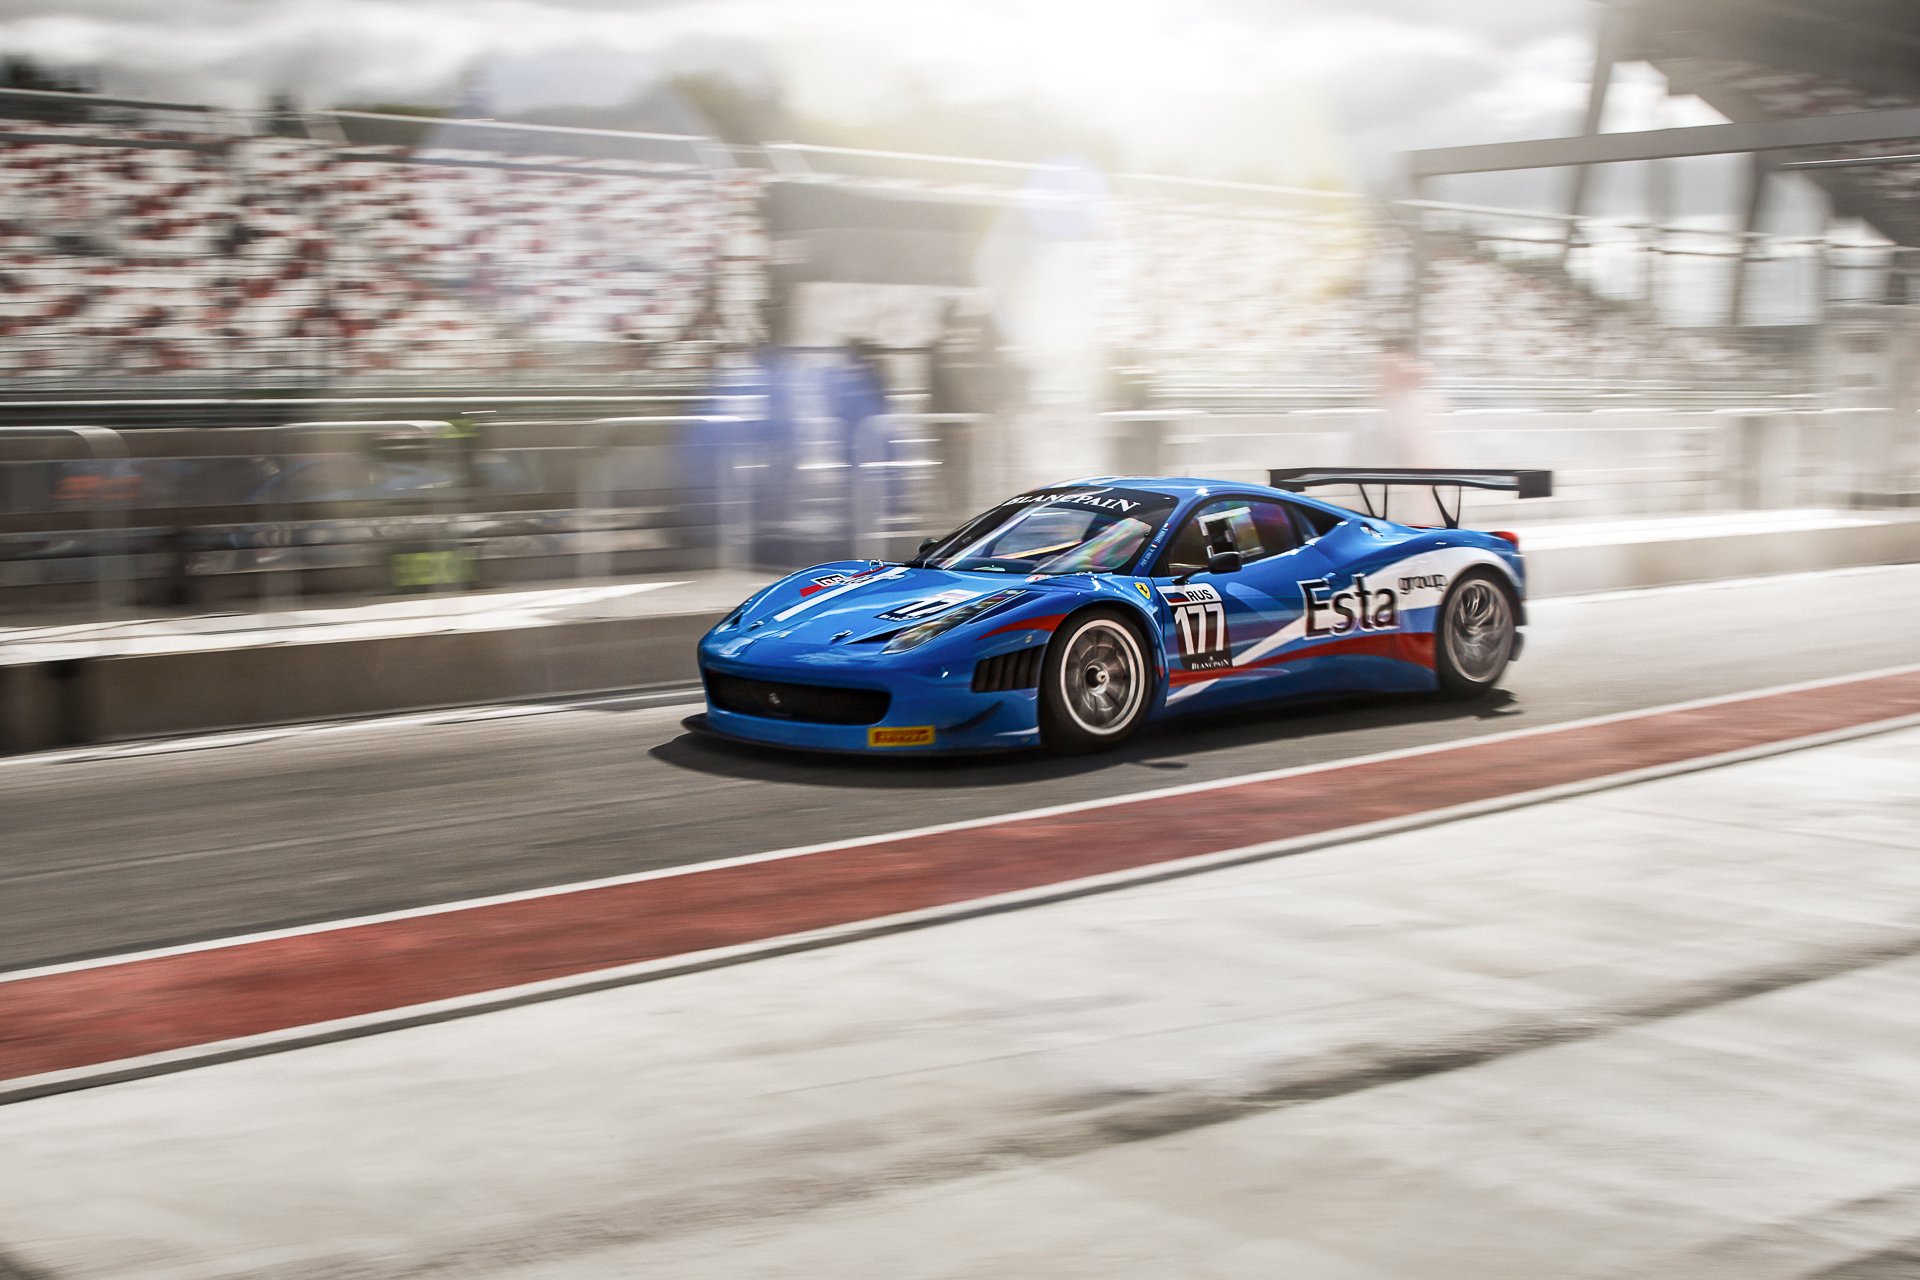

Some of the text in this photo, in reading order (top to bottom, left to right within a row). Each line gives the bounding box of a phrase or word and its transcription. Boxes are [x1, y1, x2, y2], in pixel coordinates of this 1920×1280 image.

[1001, 494, 1141, 512] BLANCPAIN
[1186, 589, 1214, 602] RUS
[1299, 573, 1448, 638] Esta group
[1174, 603, 1225, 655] 177
[1191, 658, 1230, 670] BLANCPAIN
